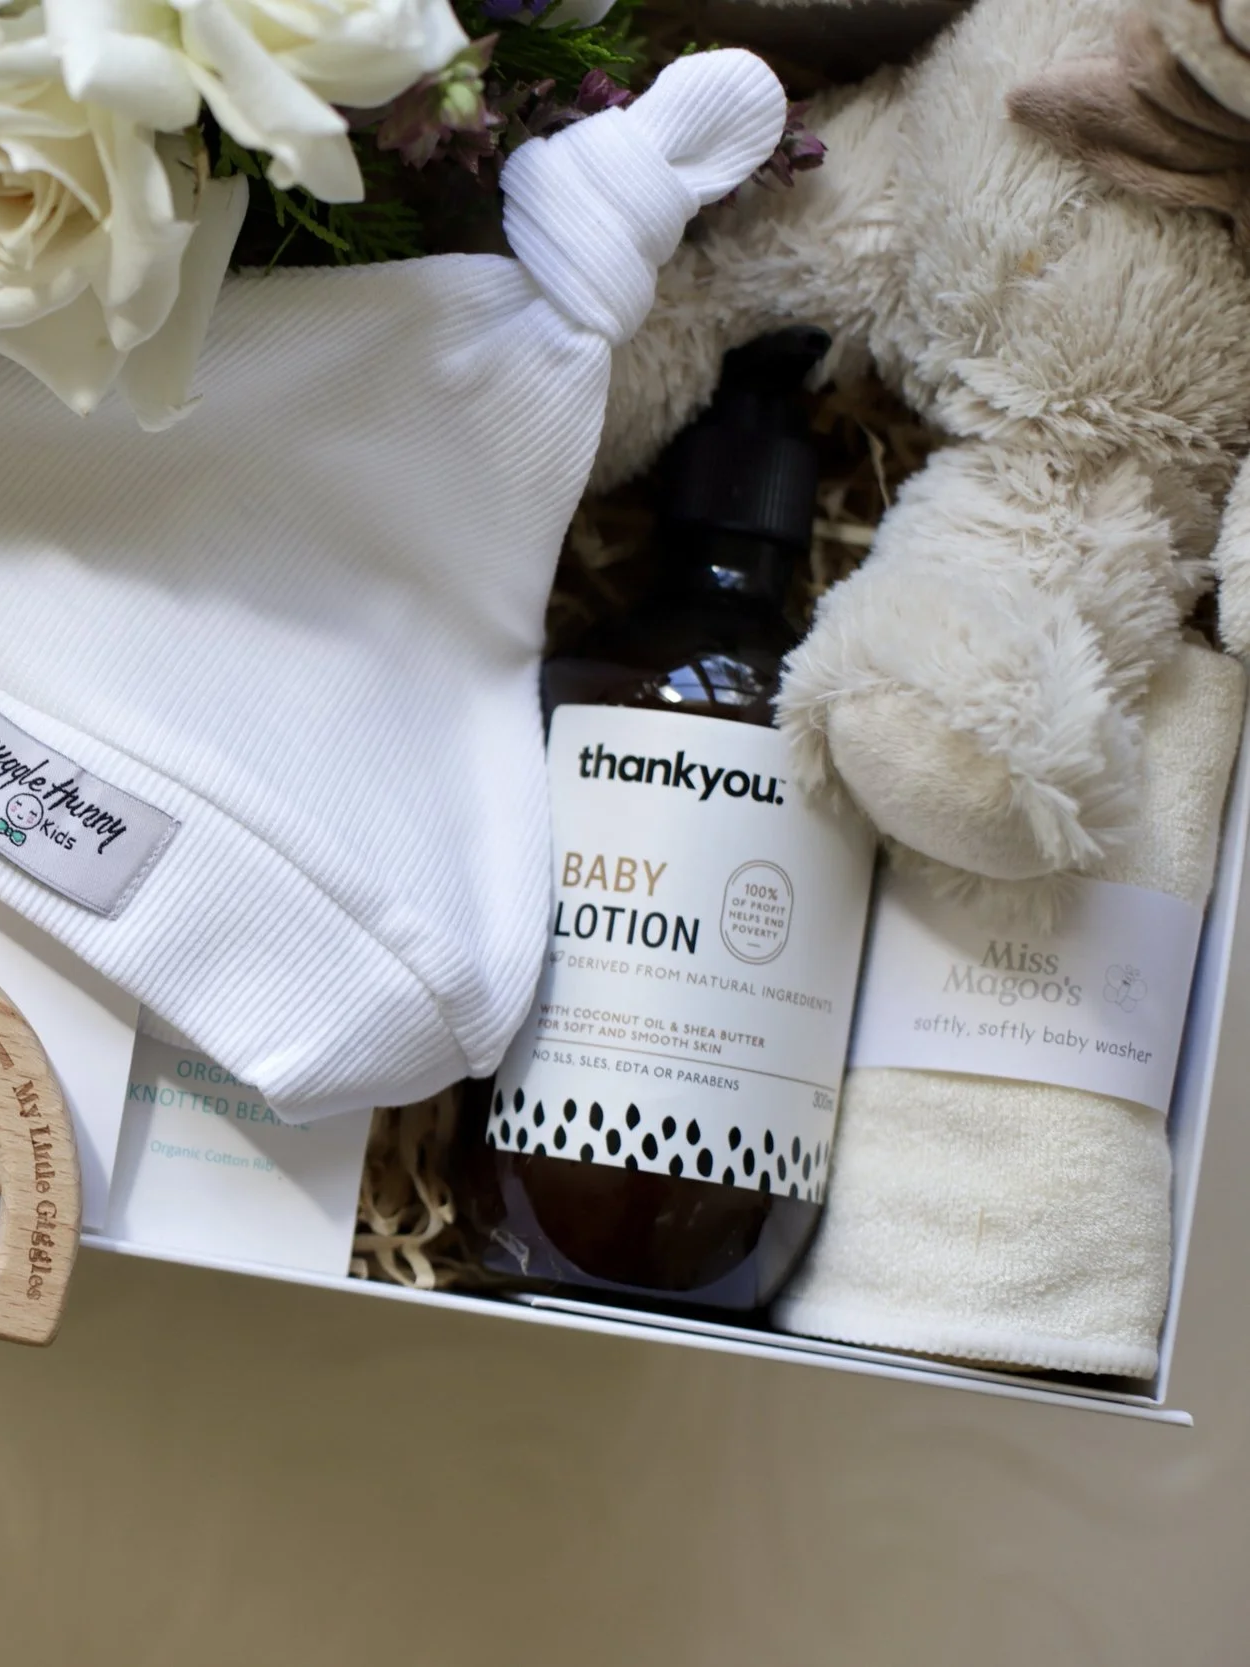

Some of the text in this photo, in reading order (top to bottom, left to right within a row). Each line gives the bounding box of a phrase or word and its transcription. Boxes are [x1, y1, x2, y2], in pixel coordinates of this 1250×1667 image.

[578, 743, 785, 806] thankyou.
[39, 818, 78, 851] Kids
[42, 778, 128, 855] Hunny
[561, 851, 669, 897] BABY
[744, 883, 779, 902] 100%
[552, 900, 701, 955] LOTION
[728, 910, 785, 929] HELPS END
[731, 897, 787, 916] OF PROFIT
[731, 923, 779, 940] POVERTY
[980, 939, 1061, 977] Miss
[566, 955, 834, 1015] DERIVED FROM NATURAL INGREDIENTS
[942, 963, 1083, 1008] Magoo's
[537, 1017, 723, 1055] FOR SOFT AND SMOOTH SKIN
[539, 1003, 766, 1049] WITH COCONUT OIL & SHEA BUTTER
[913, 1014, 1154, 1066] softly, softly baby washer
[531, 1049, 551, 1063] NO
[615, 1059, 650, 1076] EDTA
[653, 1066, 673, 1080] OR
[676, 1070, 741, 1092] PARABENS
[127, 1081, 312, 1132] KNOTTED BEA
[150, 1139, 200, 1162] Organic
[204, 1148, 251, 1170] Cotton
[11, 1079, 58, 1302] My Little Giggles
